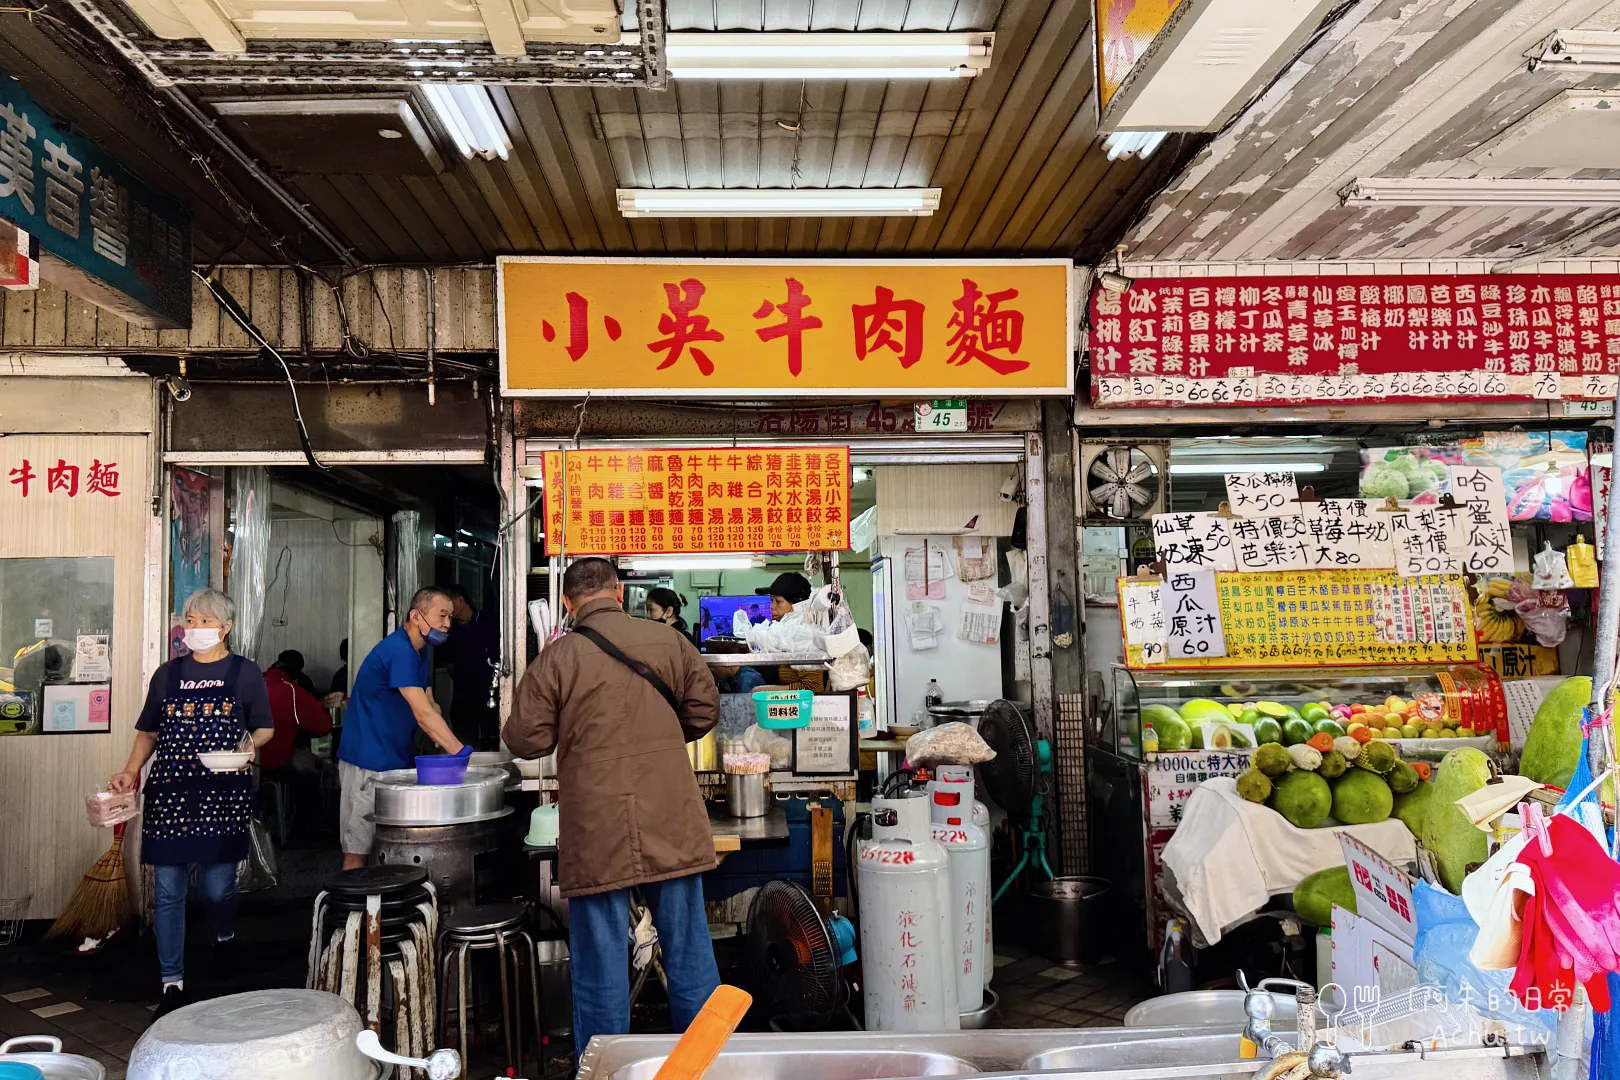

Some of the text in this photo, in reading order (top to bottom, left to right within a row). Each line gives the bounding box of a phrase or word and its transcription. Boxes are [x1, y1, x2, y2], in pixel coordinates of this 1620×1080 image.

[542, 277, 1031, 377] 小吳牛肉麵
[1129, 288, 1157, 373] 冰紅茶
[1189, 287, 1210, 376] 百香果汁
[1215, 286, 1236, 353] 檸檬汁
[1239, 286, 1260, 353] 柳丁汁
[1262, 286, 1284, 352] 冬瓜茶
[1312, 285, 1335, 351] 仙草冰
[1360, 286, 1382, 351] 酸梅汁
[1383, 285, 1405, 327] 椰奶
[1407, 285, 1429, 350] 鳳梨汁
[1430, 285, 1453, 350] 芭樂汁
[1455, 285, 1478, 350] 西瓜汁
[1480, 285, 1506, 372] 綠豆沙牛奶
[1506, 284, 1531, 373] 珍珠奶茶
[1531, 285, 1555, 372] 木瓜牛奶
[1576, 285, 1602, 371] 酪梨牛奶
[1162, 296, 1184, 372] 茉莉綠茶
[1287, 300, 1309, 366] 青草茶
[1103, 385, 1122, 397] 30
[1134, 382, 1154, 396] 30
[1165, 382, 1184, 395] 30
[1188, 388, 1209, 400] 60
[1233, 386, 1253, 398] 90
[1264, 382, 1286, 394] 30
[1317, 387, 1336, 397] 50
[1363, 382, 1384, 394] 50
[1390, 381, 1410, 394] 50
[1413, 383, 1432, 394] 60
[1457, 382, 1478, 394] 60
[1484, 382, 1506, 393] 60
[1534, 382, 1557, 396] 70
[1587, 384, 1608, 395] 70
[933, 413, 951, 426] 45
[9, 459, 121, 498] 牛肉麵
[587, 455, 605, 526] 牛肉麵
[607, 455, 625, 526] 牛雜麵
[627, 455, 646, 526] 綜合麵
[647, 455, 665, 526] 麻醬麵
[667, 455, 685, 526] 魯肉乾麵
[687, 453, 704, 525] 牛肉湯麵
[707, 454, 724, 525] 牛肉湯
[727, 454, 744, 525] 牛雜湯
[746, 454, 763, 525] 綜合湯
[786, 453, 802, 524] 韭菜水餃
[825, 453, 841, 523] 各式小菜
[1228, 471, 1295, 492] 冬瓜檸檬
[1154, 514, 1195, 536] 仙草
[1233, 517, 1283, 540] 特價
[1307, 517, 1389, 544] 草莓牛奶
[1318, 500, 1368, 518] 特價
[1206, 533, 1230, 551] 50
[1241, 540, 1310, 567] 芭樂汁
[1403, 531, 1450, 555] 特價
[1470, 552, 1499, 571] 60
[1144, 643, 1161, 658] 90
[1183, 639, 1209, 655] 60
